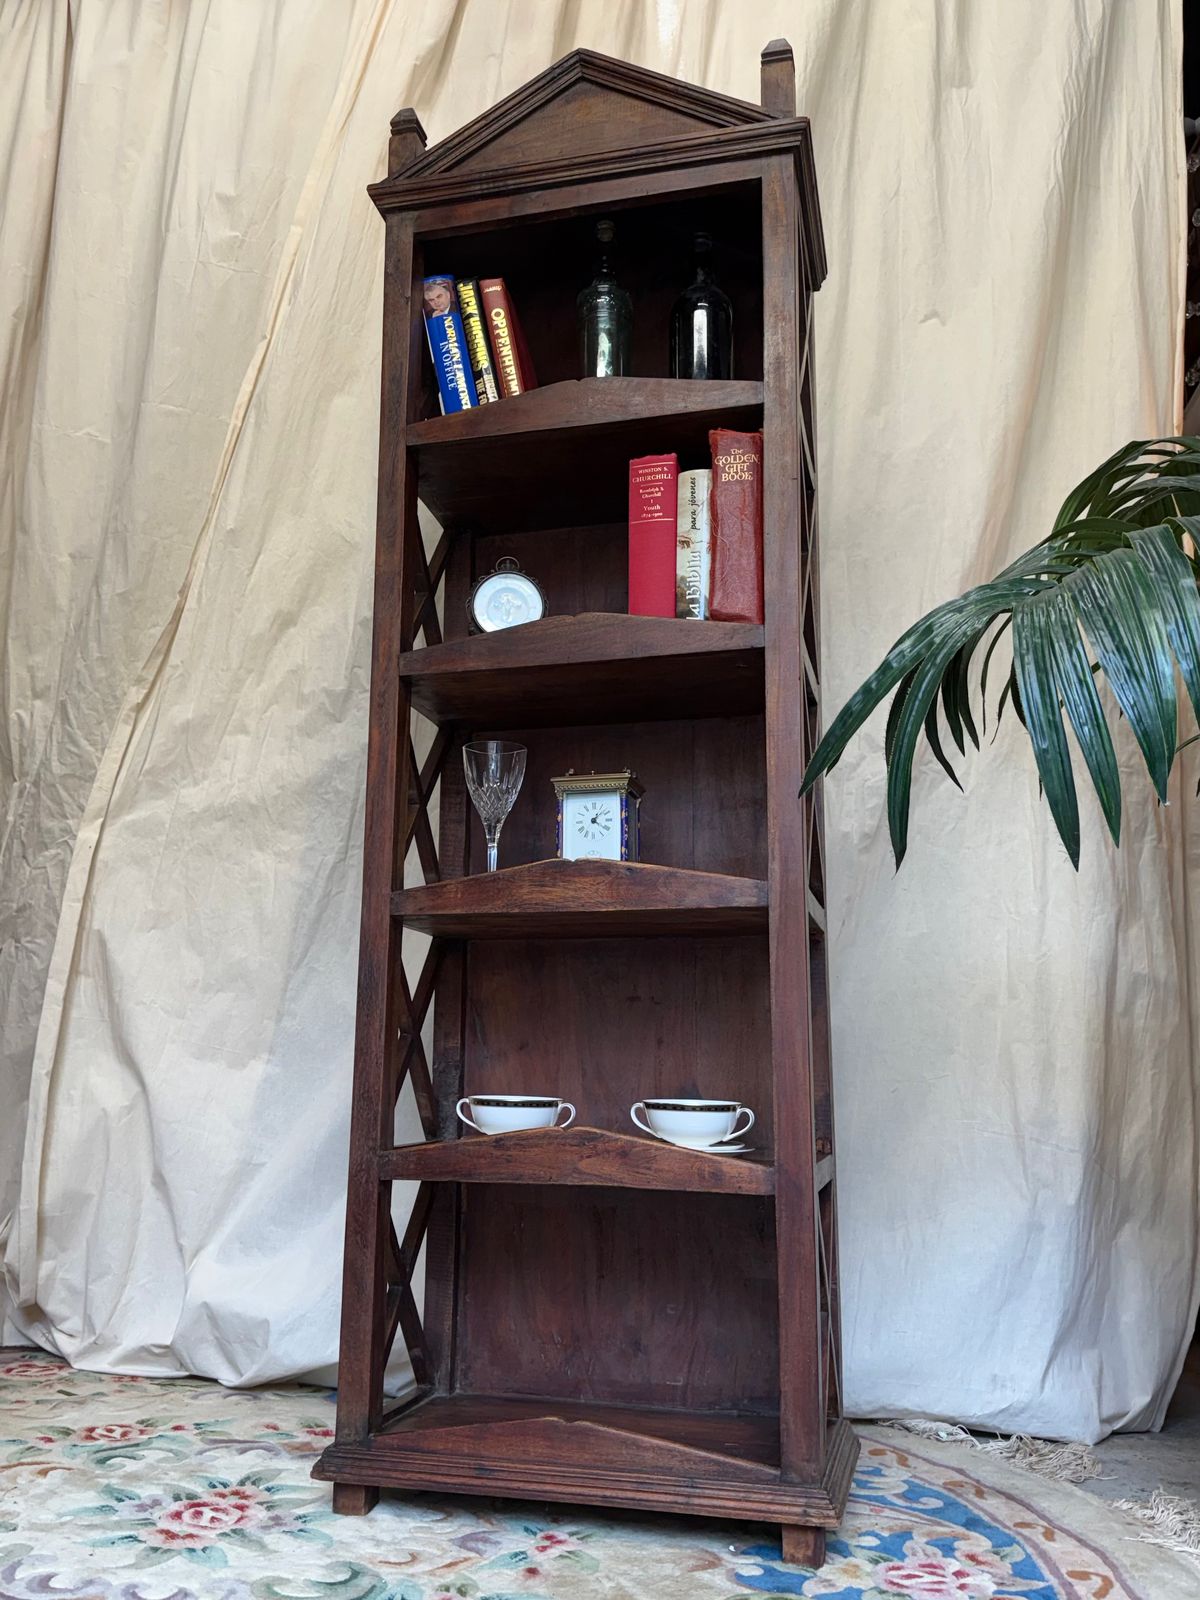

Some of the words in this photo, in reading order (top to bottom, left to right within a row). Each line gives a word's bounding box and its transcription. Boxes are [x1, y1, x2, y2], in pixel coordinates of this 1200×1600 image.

[457, 282, 479, 318] JACK
[440, 341, 449, 352] IN
[443, 316, 461, 361] NORMAN
[463, 316, 489, 372] HIGGINS
[443, 354, 457, 390] OFFICE
[475, 377, 486, 395] THE
[715, 454, 759, 466] GOLDEN
[725, 463, 749, 473] GIFT
[632, 473, 673, 483] CHURCHILL
[722, 472, 753, 482] BOOK
[688, 477, 701, 507] jóvenes
[690, 508, 701, 531] para
